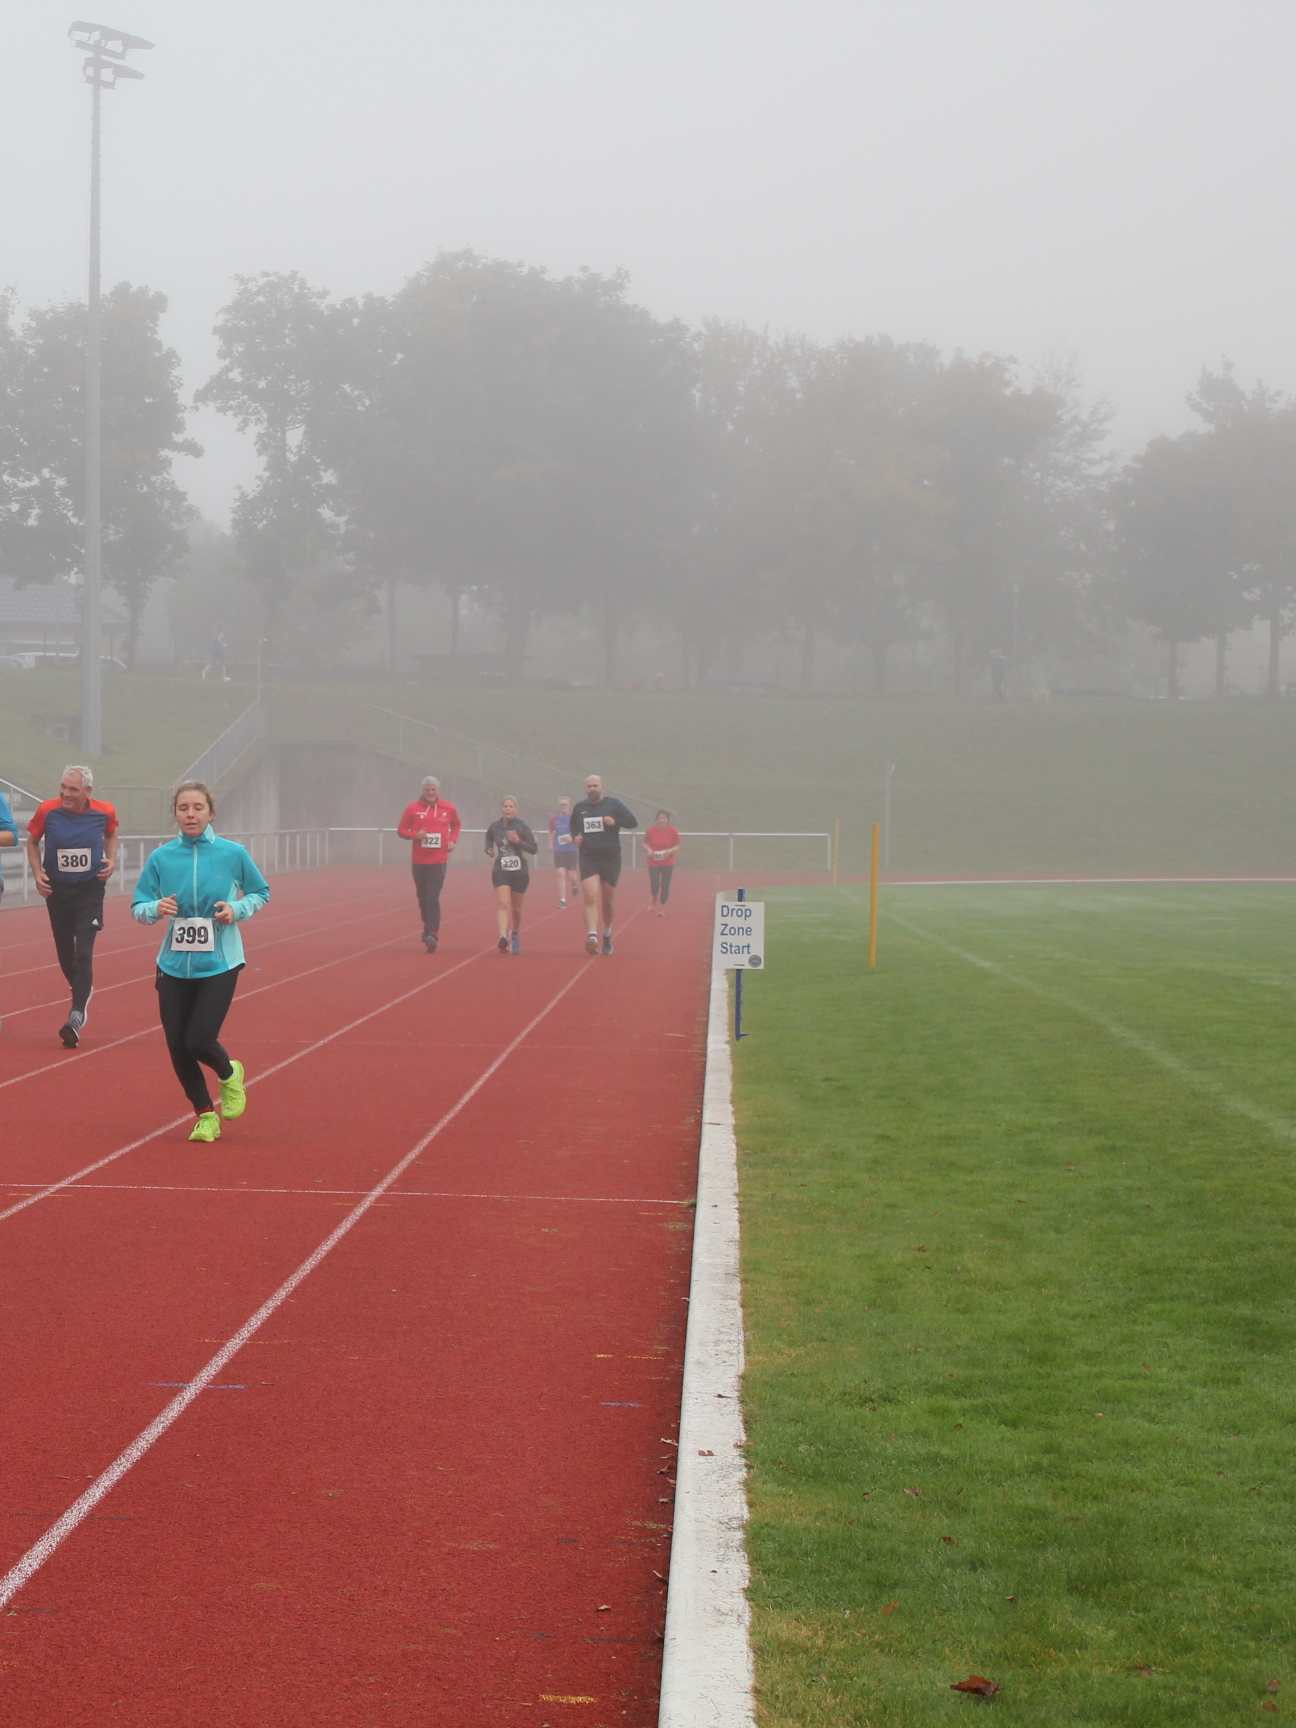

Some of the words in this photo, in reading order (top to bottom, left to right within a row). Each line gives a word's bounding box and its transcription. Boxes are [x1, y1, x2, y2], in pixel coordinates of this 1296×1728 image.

[61, 854, 88, 867] 380
[720, 904, 752, 920] Drop
[175, 926, 209, 944] 399
[719, 923, 753, 937] Zone
[720, 942, 752, 955] Start
